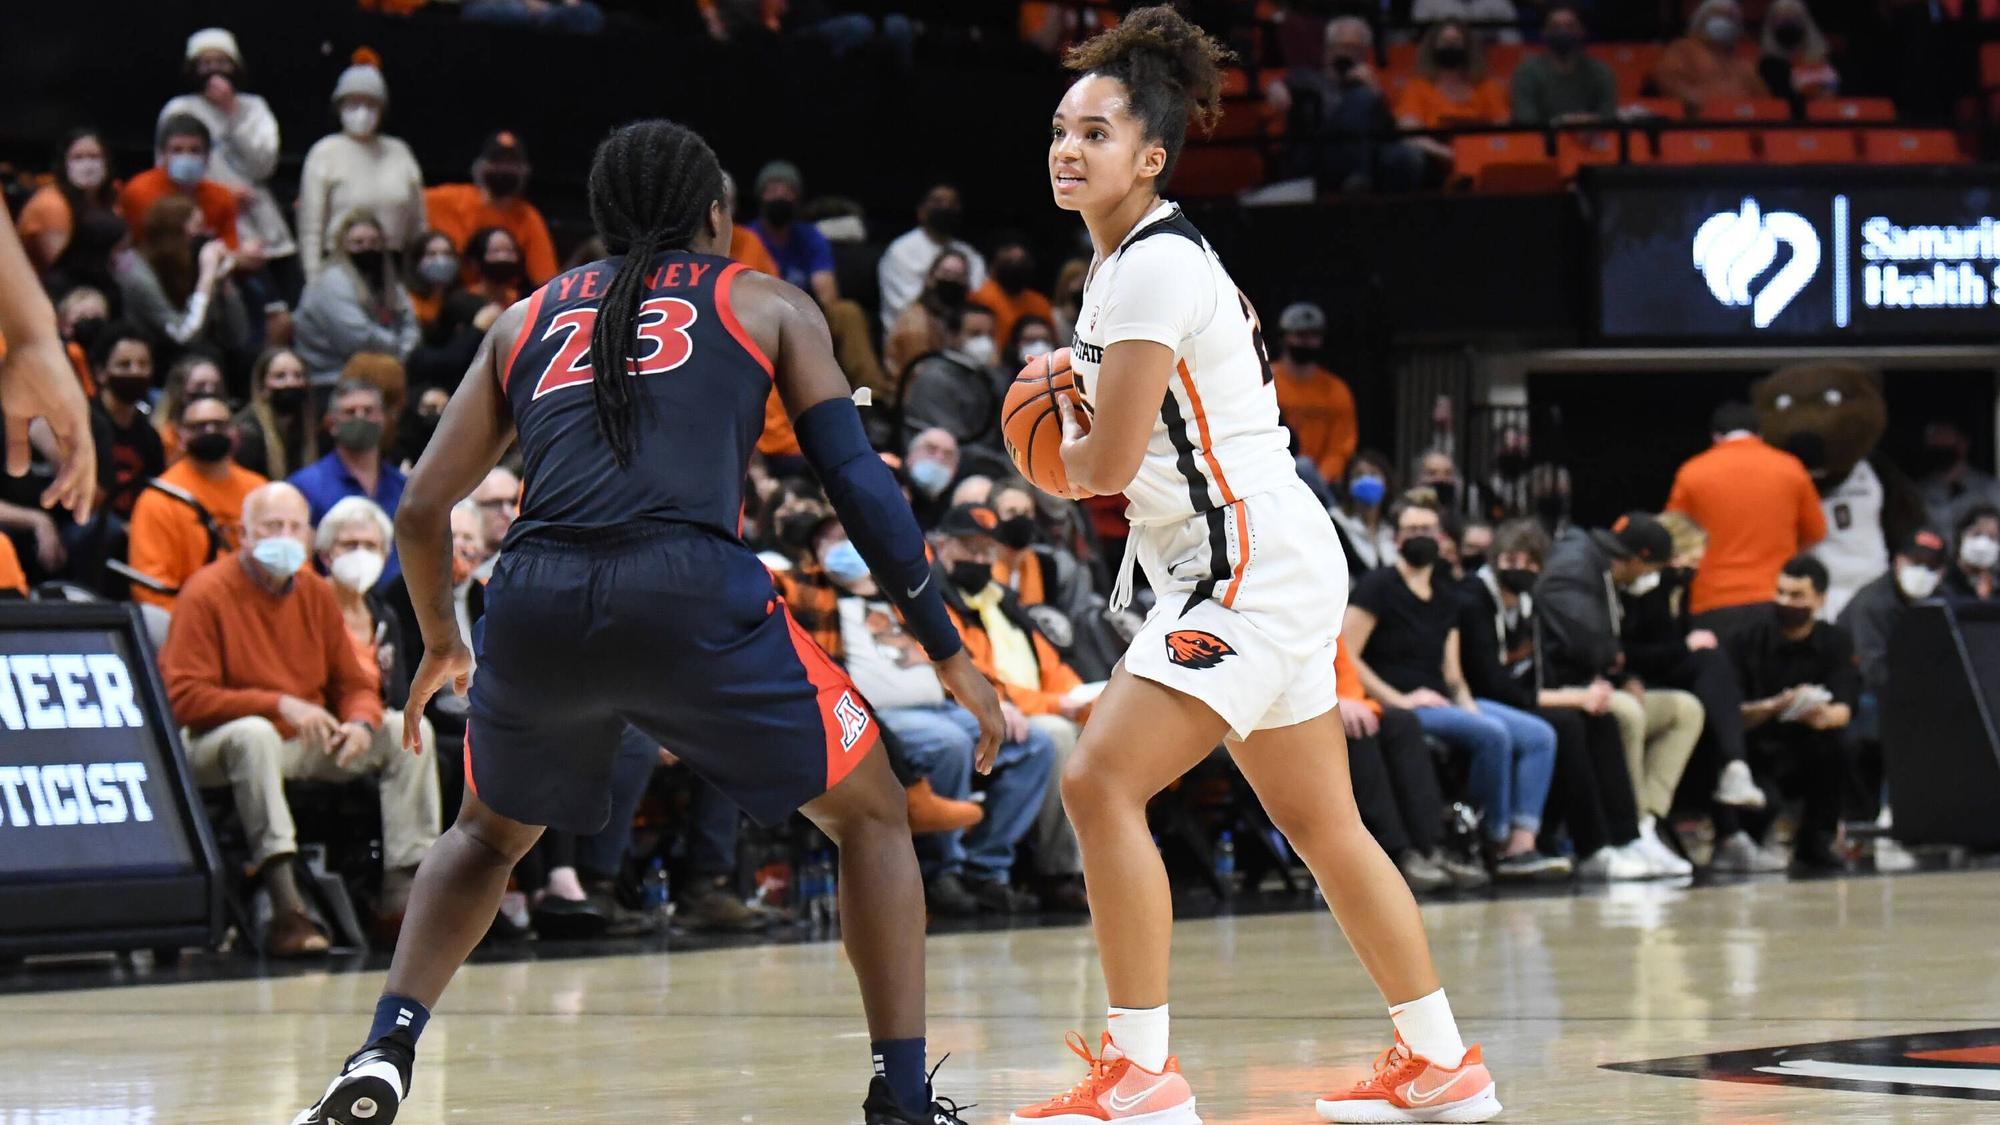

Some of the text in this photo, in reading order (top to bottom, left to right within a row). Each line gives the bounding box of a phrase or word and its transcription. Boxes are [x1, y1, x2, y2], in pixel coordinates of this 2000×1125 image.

[1863, 262, 1987, 308] Health
[532, 297, 698, 400] 23
[0, 762, 154, 826] TICIST
